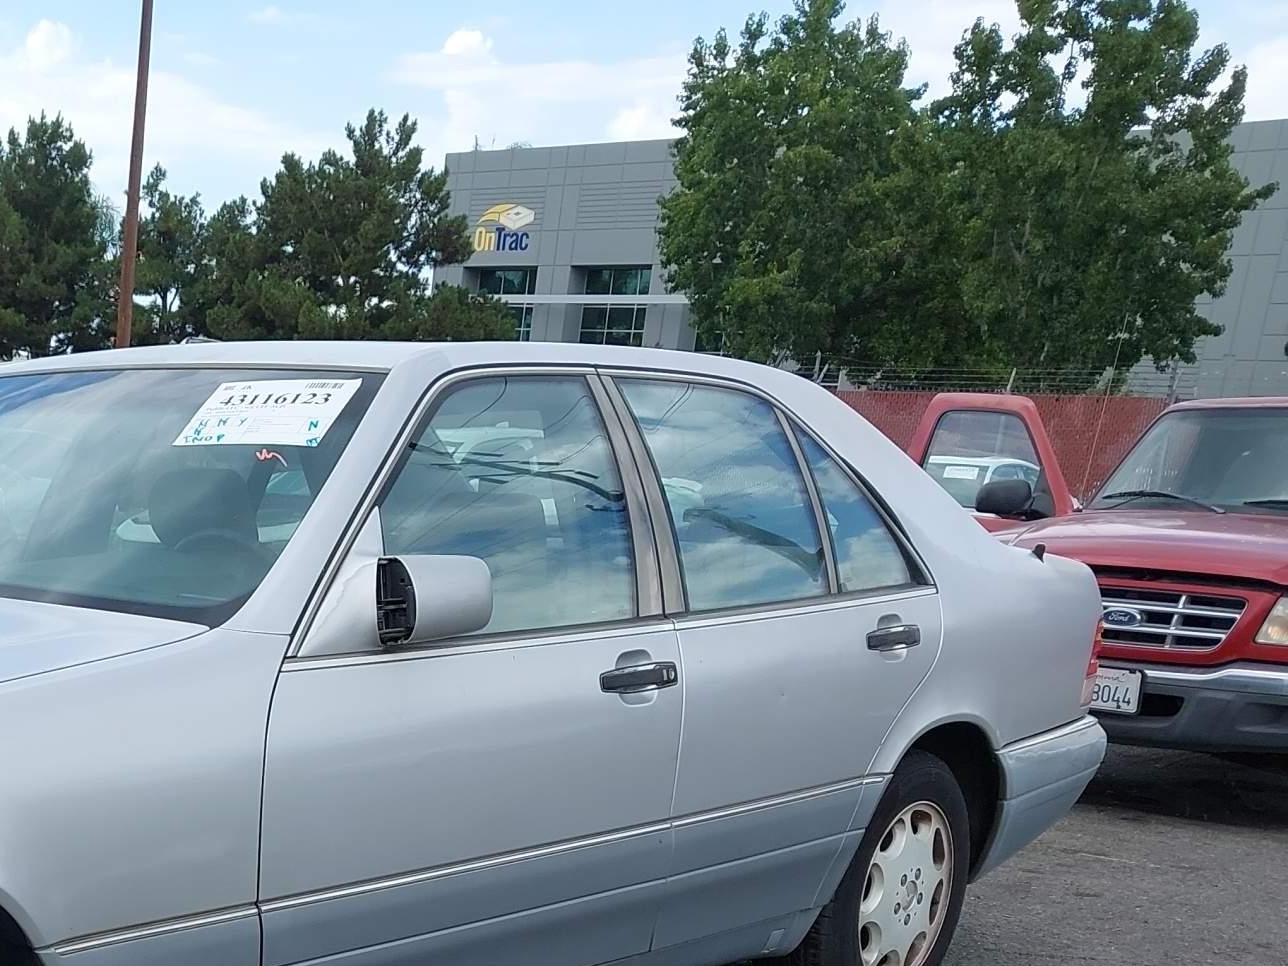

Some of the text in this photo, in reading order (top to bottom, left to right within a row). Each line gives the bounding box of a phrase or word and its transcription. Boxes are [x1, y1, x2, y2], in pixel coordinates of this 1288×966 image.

[474, 226, 529, 251] OnTrac
[219, 391, 332, 406] 43116123
[1108, 609, 1130, 622] Ford
